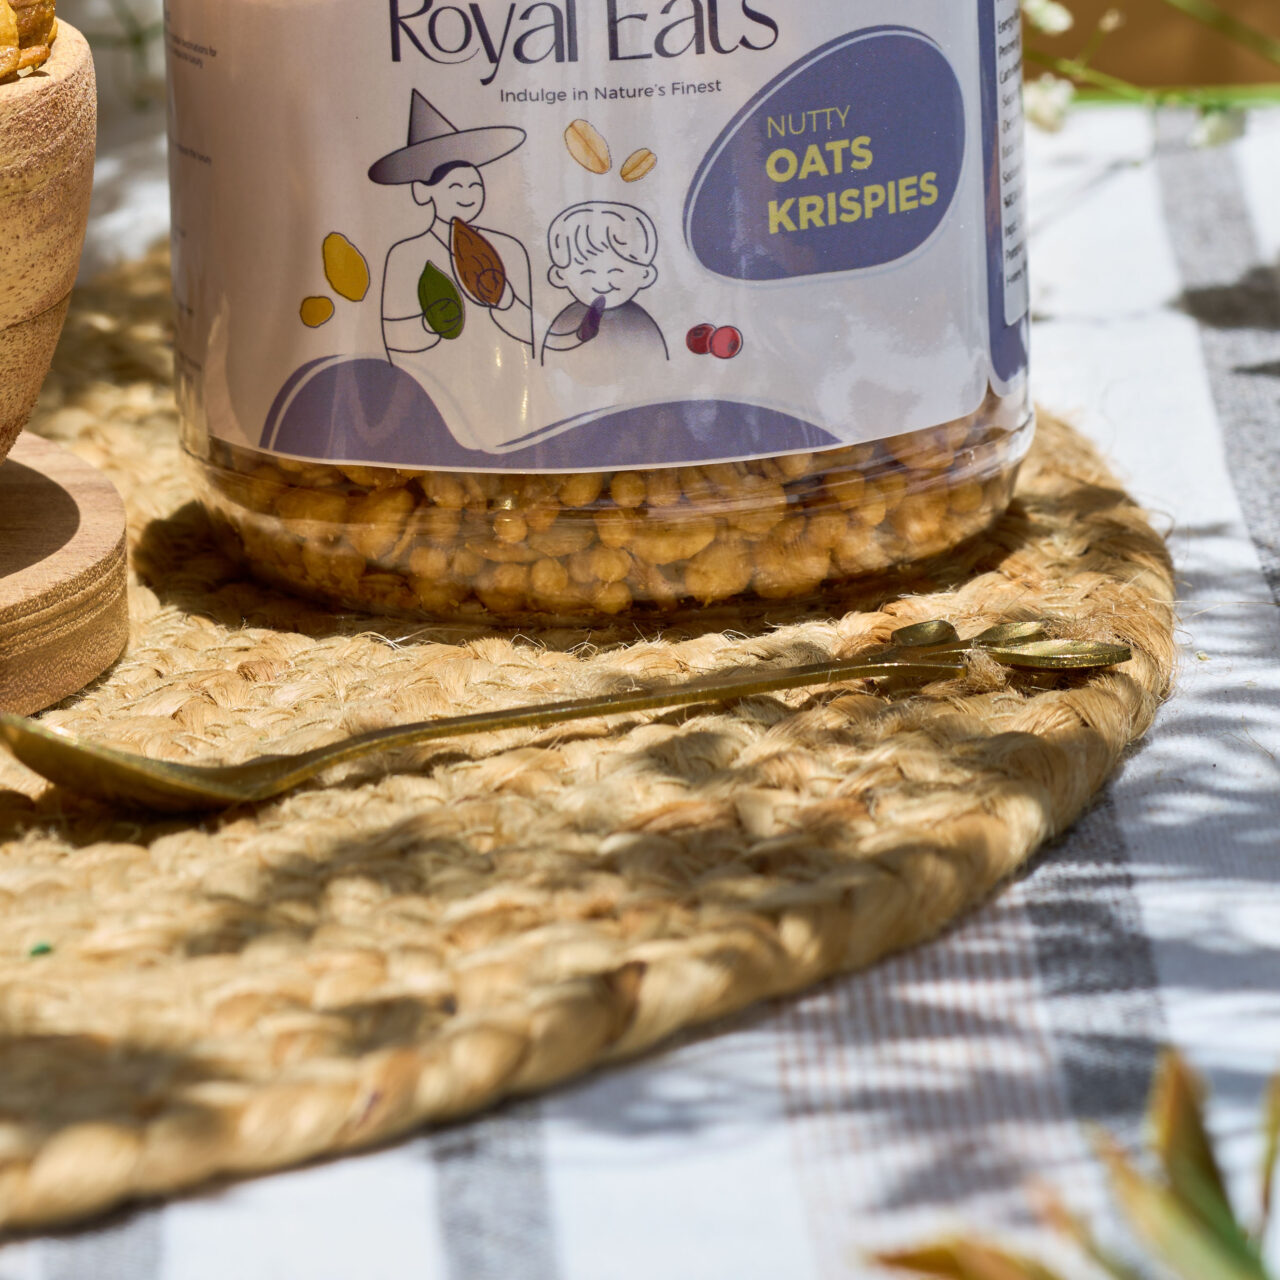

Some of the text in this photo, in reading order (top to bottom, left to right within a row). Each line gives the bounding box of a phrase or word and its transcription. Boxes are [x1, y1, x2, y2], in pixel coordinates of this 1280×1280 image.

[500, 79, 722, 104] Indulge in Nature's Finest
[767, 104, 851, 139] NUTTY
[765, 135, 873, 183] OATS
[767, 171, 939, 235] KRISPIES
